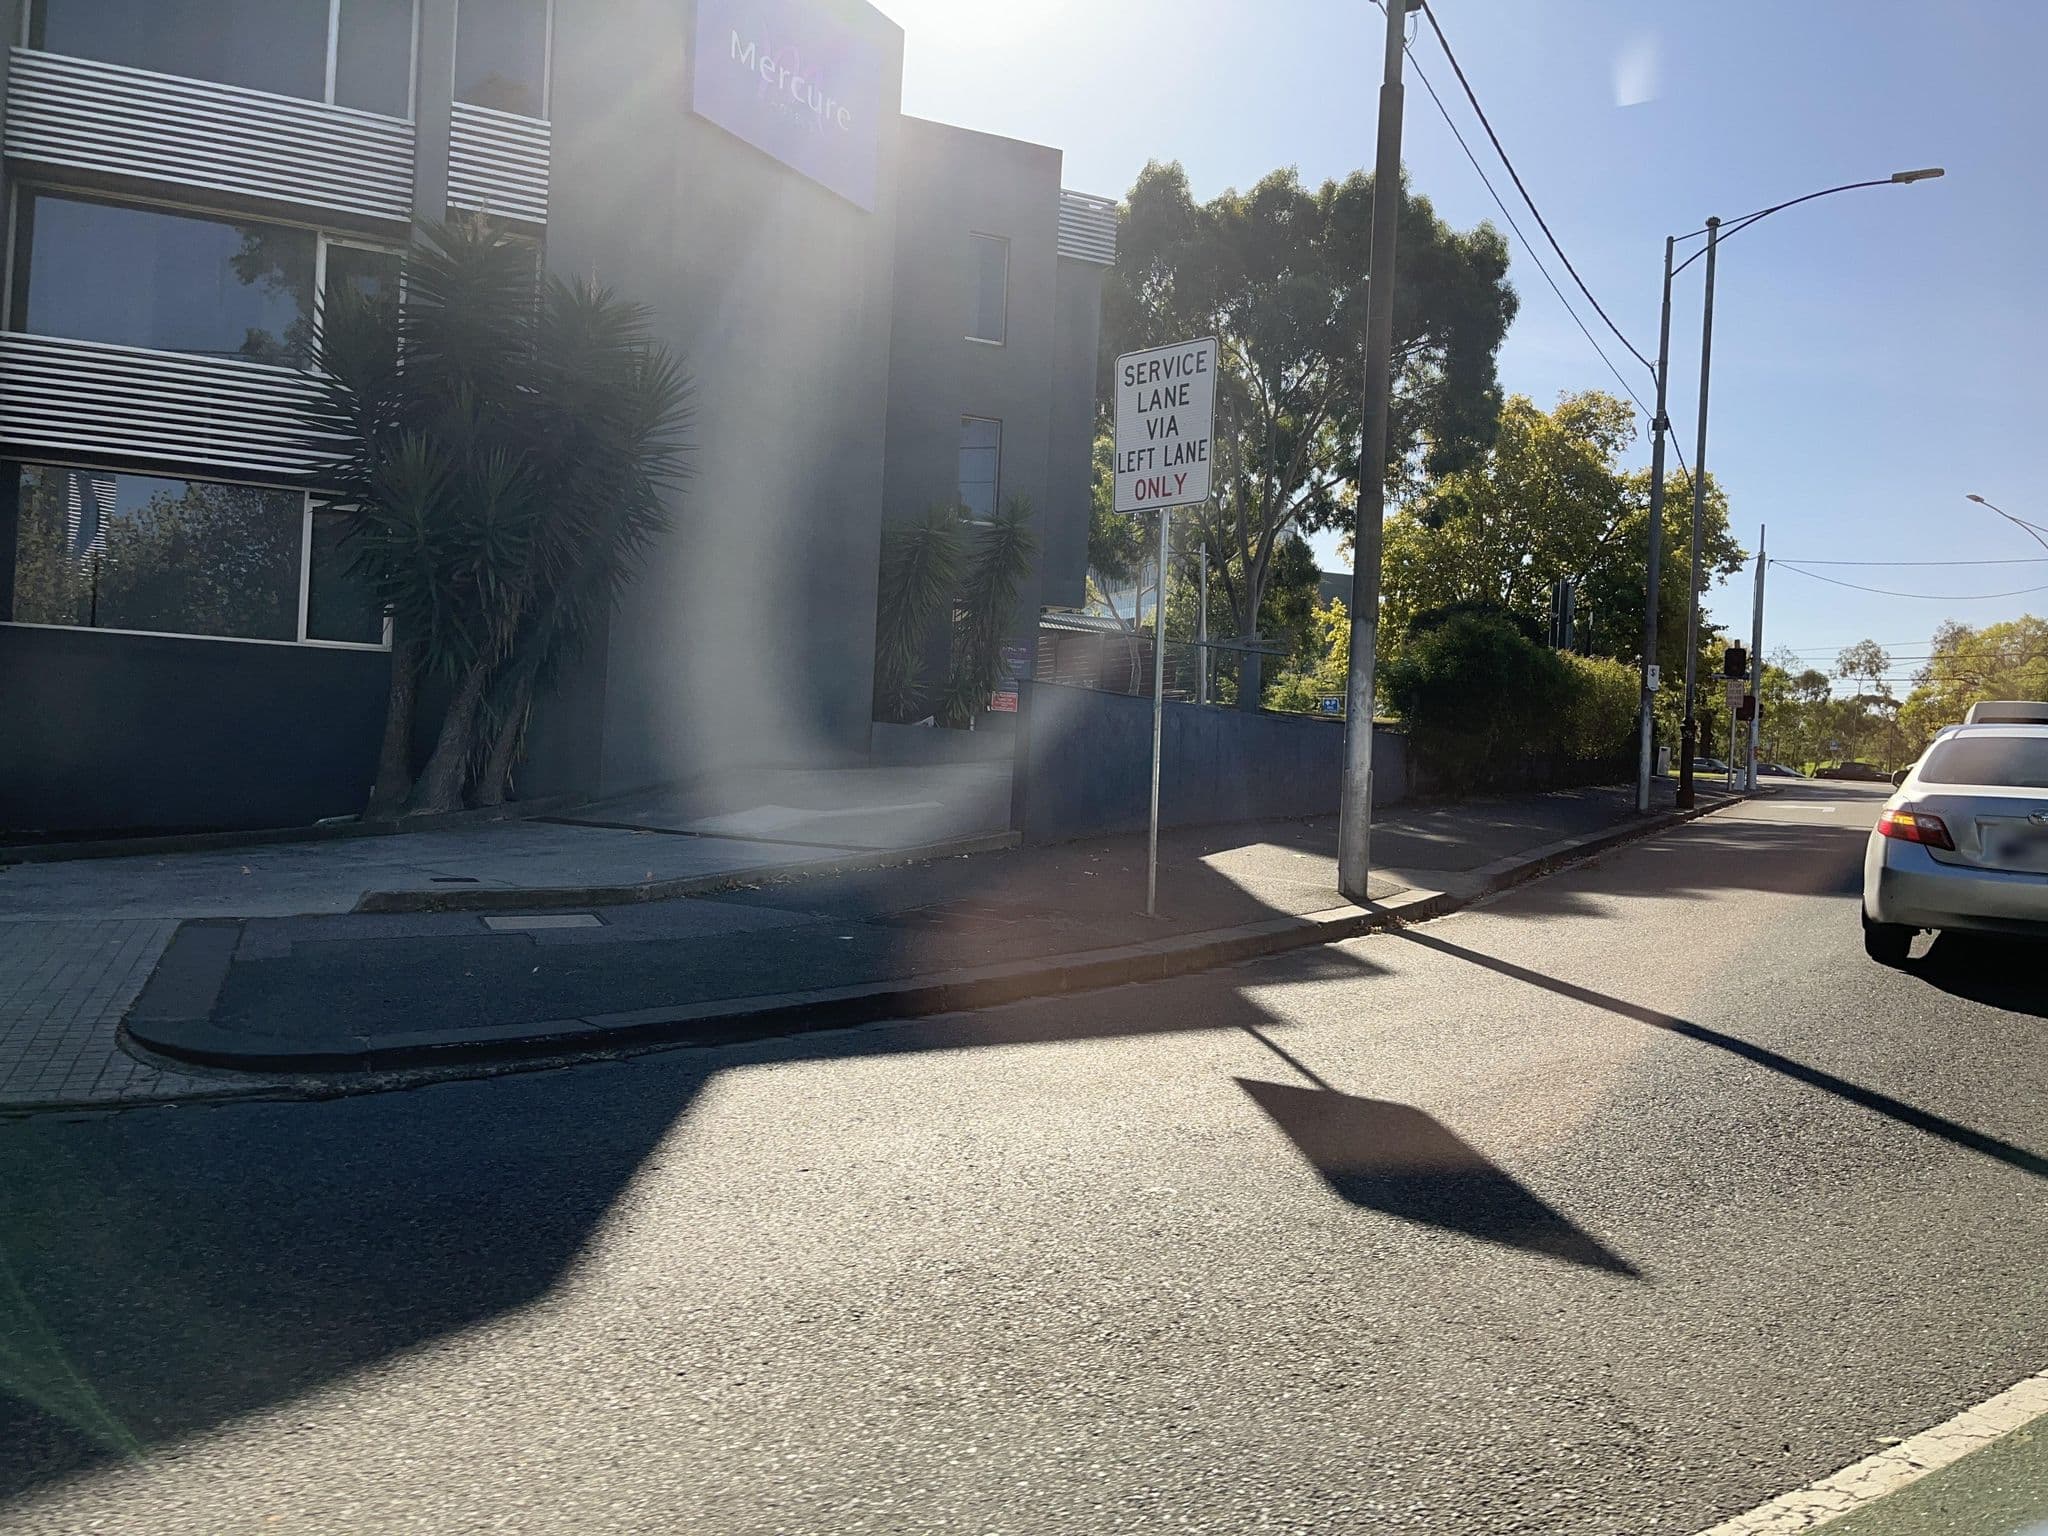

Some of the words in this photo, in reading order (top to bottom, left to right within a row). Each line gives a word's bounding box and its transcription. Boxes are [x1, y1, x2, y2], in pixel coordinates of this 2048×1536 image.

[730, 29, 851, 131] Mercure
[1124, 350, 1208, 387] SERVICE
[1137, 383, 1190, 414] LANE
[1146, 415, 1179, 441] VIA
[1117, 447, 1156, 474] LEFT
[1164, 439, 1208, 467] LANE
[1135, 472, 1188, 501] ONLY
